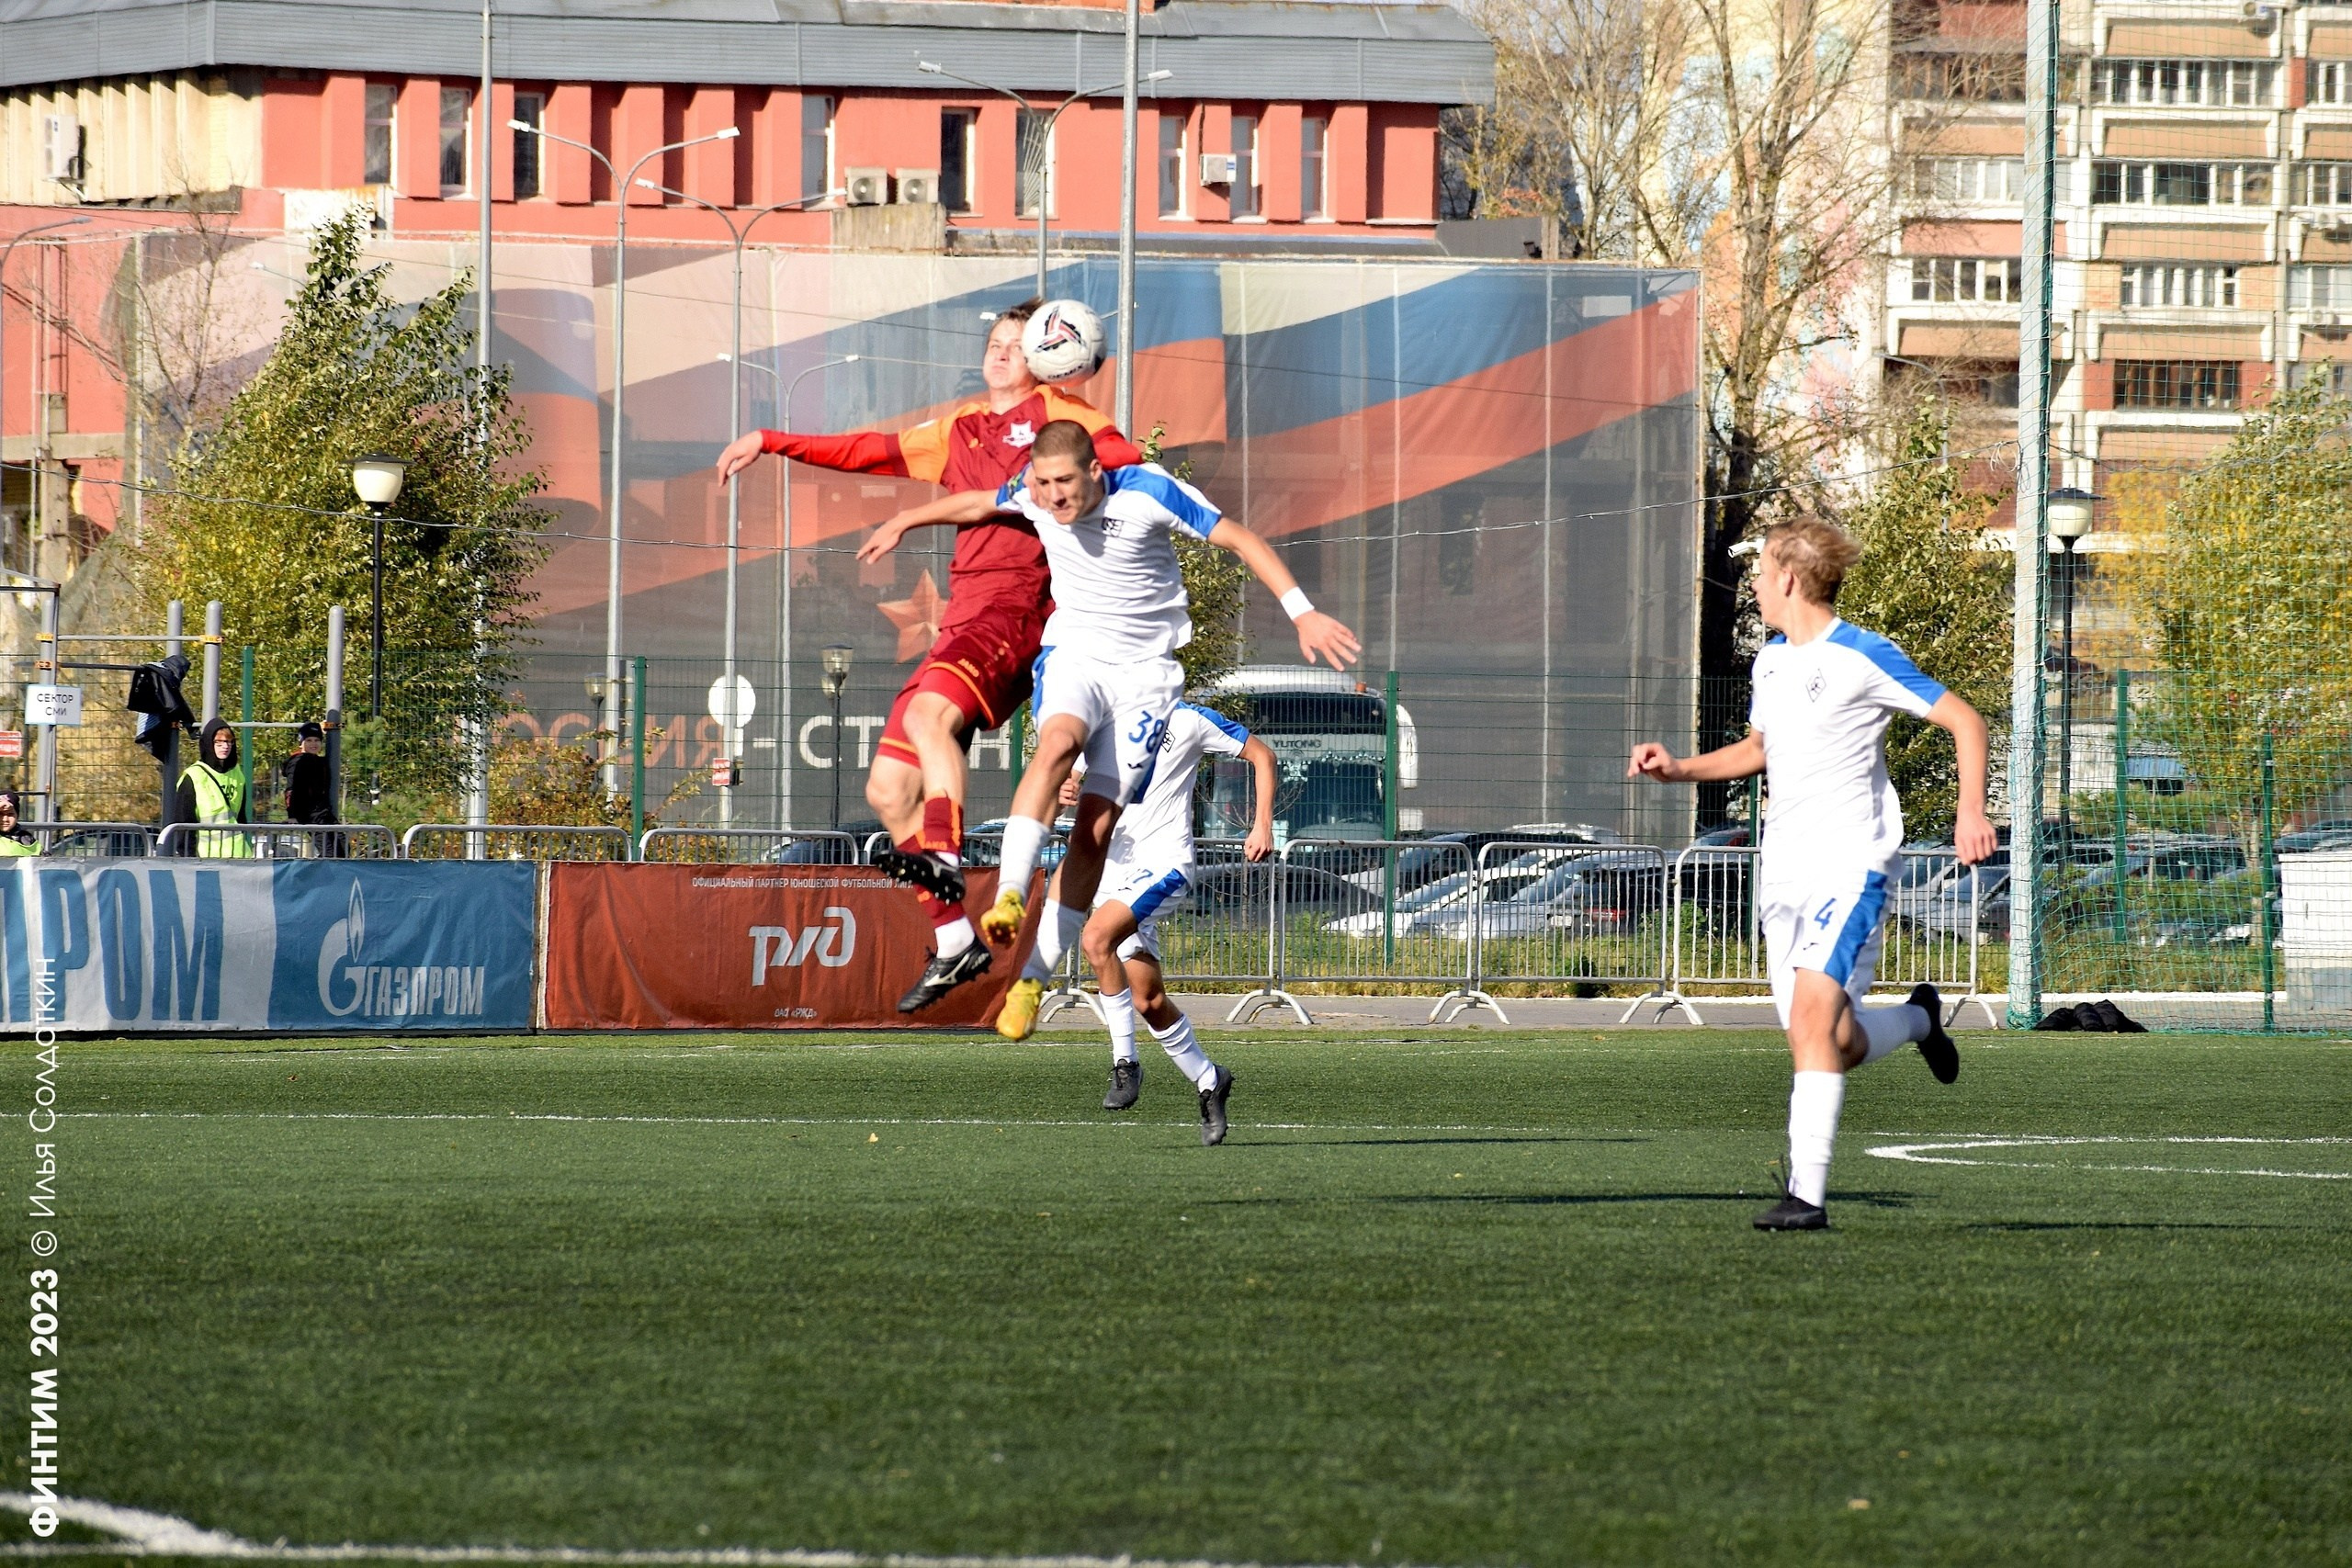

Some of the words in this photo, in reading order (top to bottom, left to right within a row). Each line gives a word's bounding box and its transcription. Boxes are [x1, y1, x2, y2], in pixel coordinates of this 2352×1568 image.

[37, 694, 74, 704] СЕКТОР
[45, 706, 67, 716] СМИ
[1128, 710, 1164, 753] 38
[1272, 739, 1321, 748] YUTONG
[692, 876, 753, 888] ОФИЦИАЛЬНЫЙ
[755, 878, 788, 888] ПАРТНЕР
[790, 876, 840, 888] ЮНОШЕСКОЙ
[842, 876, 893, 888] ФУТБОЛЬНОЙ
[1814, 897, 1837, 931] 4
[364, 966, 485, 1016] ГАЗПРОМ
